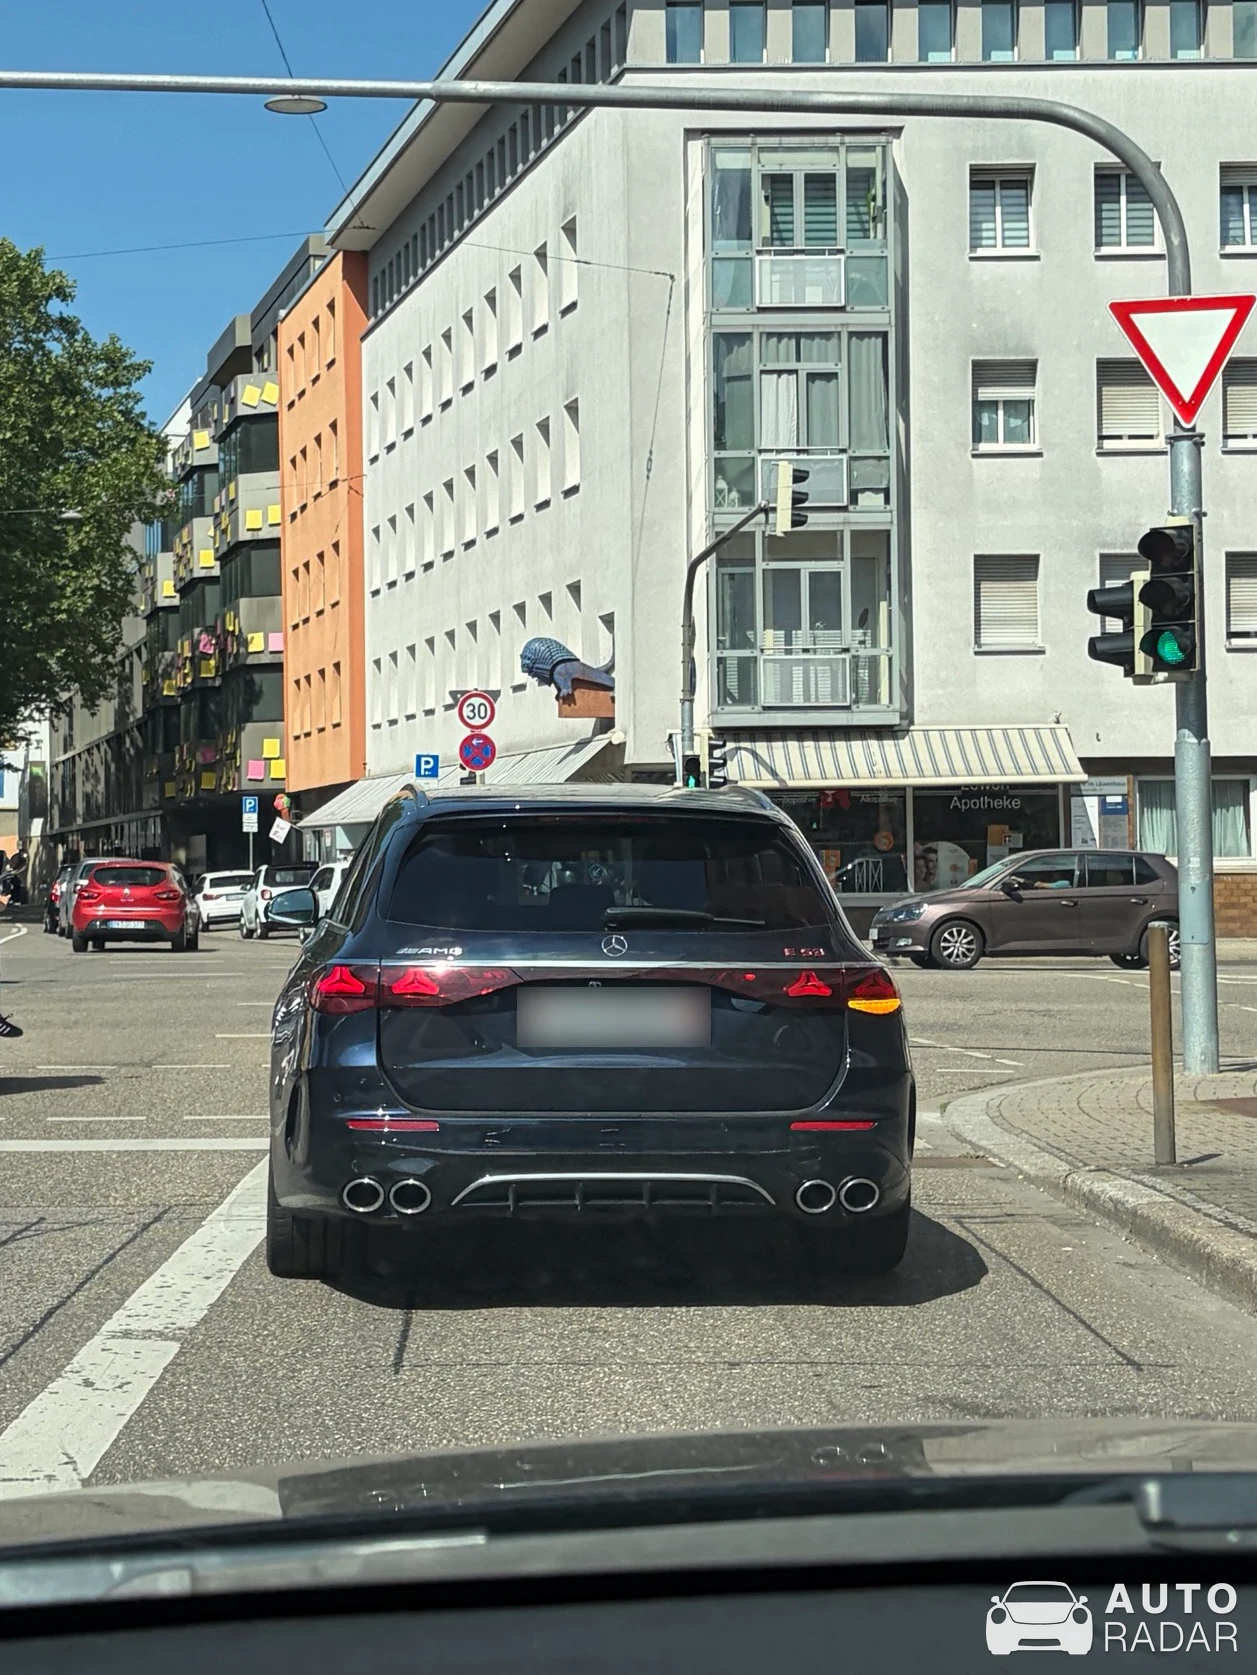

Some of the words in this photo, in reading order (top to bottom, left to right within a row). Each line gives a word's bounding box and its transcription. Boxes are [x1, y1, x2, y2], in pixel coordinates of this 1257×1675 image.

[466, 702, 488, 720] 30
[420, 757, 434, 776] P
[245, 798, 255, 812] P
[950, 795, 1021, 812] Apotheke
